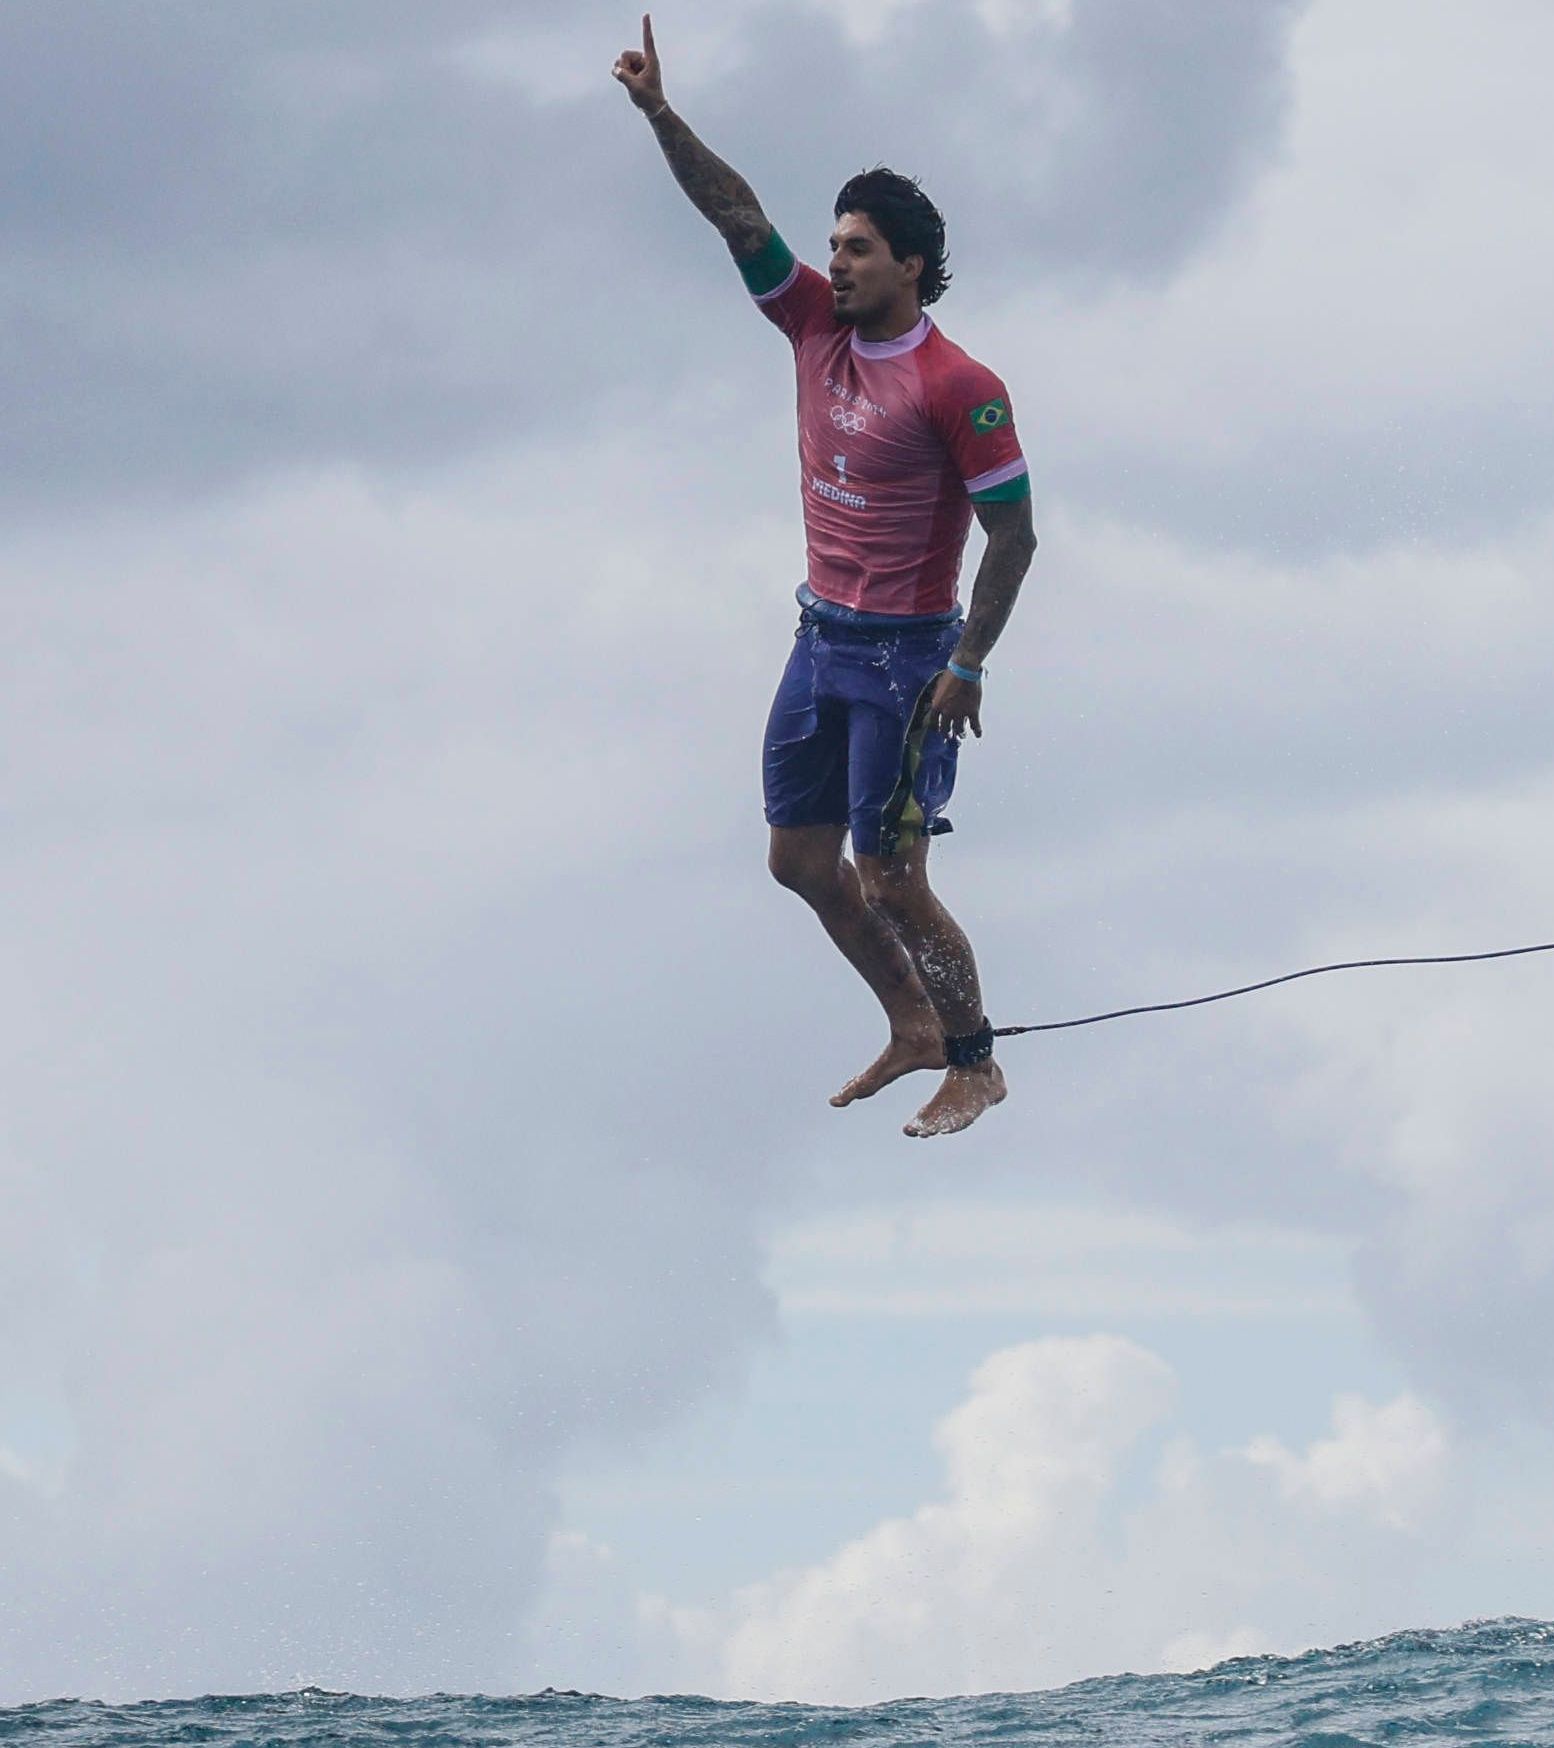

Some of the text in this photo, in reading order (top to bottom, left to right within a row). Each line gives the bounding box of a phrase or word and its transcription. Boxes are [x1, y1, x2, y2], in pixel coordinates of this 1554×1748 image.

[824, 377, 861, 405] PARIS
[833, 455, 847, 484] 1
[811, 476, 866, 509] MEDINA
